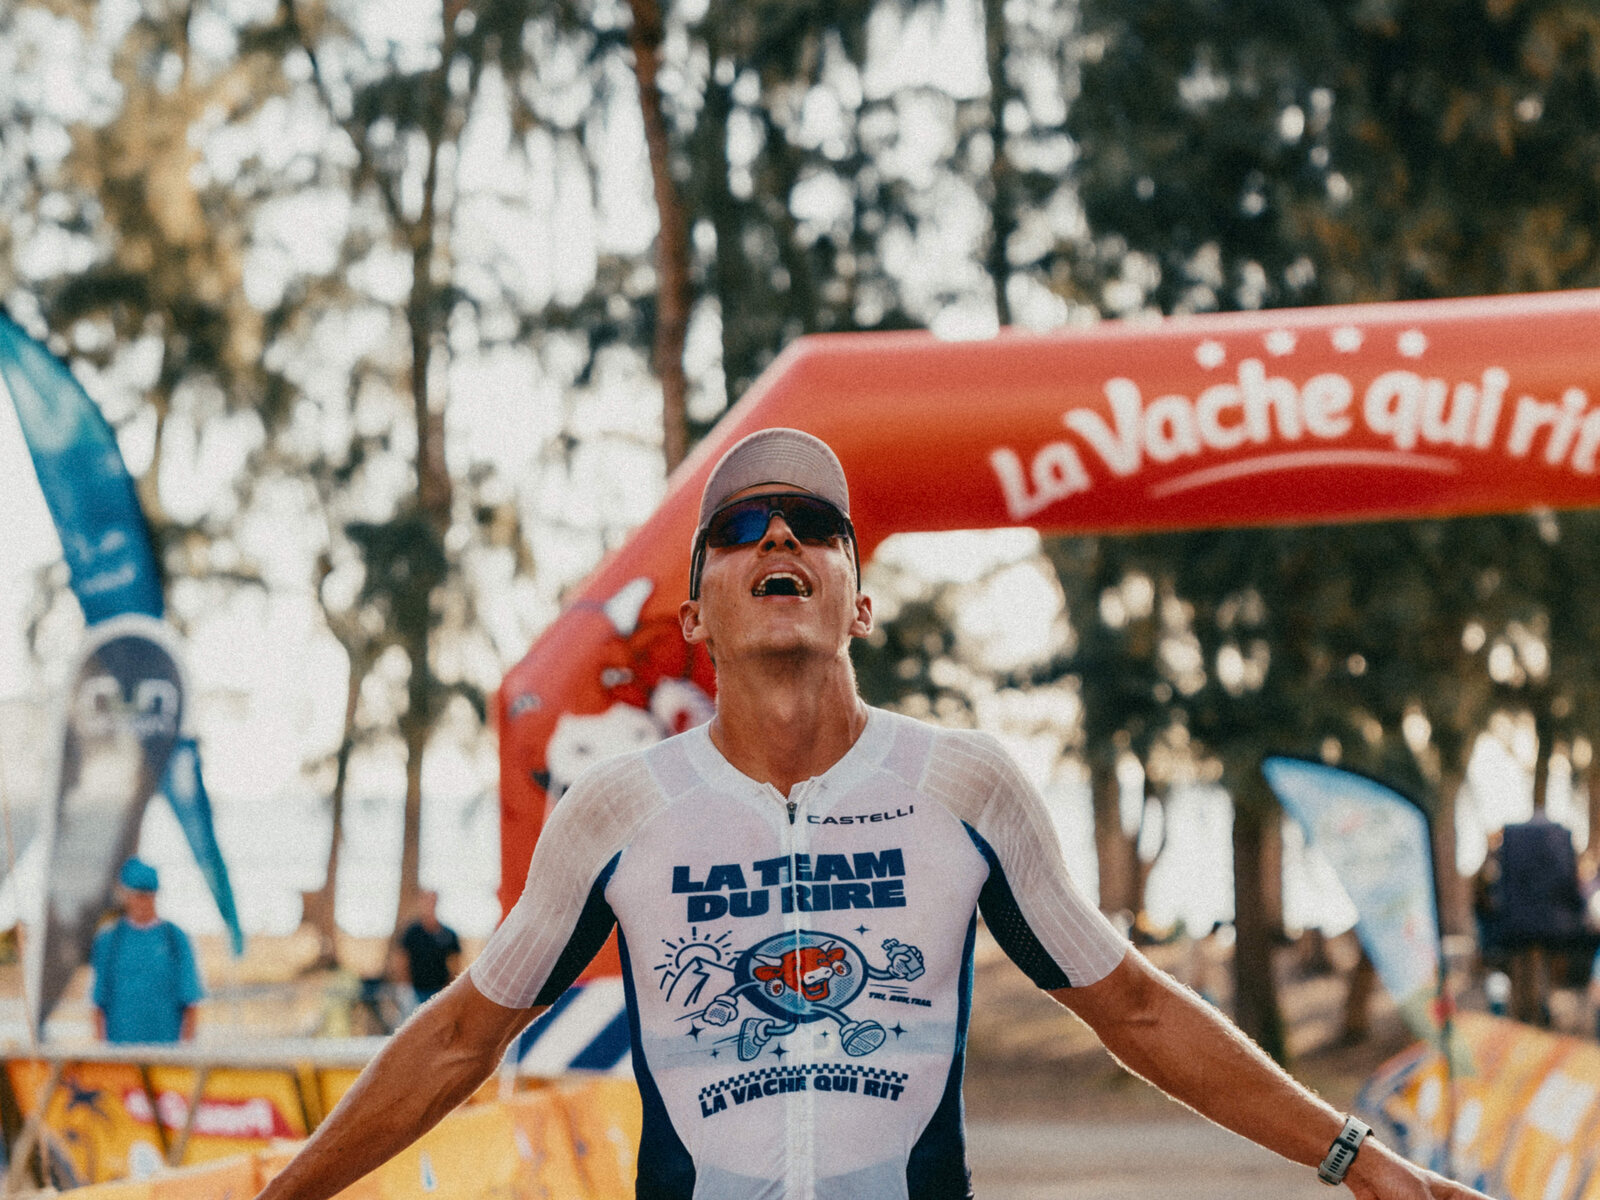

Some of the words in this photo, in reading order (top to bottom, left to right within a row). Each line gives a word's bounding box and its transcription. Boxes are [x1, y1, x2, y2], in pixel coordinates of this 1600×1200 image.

[989, 444, 1091, 519] La
[1063, 358, 1354, 477] Vache
[1363, 367, 1509, 450] qui
[807, 805, 914, 824] CASTELLI
[672, 864, 747, 894] LA
[753, 848, 906, 887] TEAM
[687, 890, 769, 923] DU
[781, 879, 907, 914] RIRE
[700, 1094, 728, 1118] LA
[731, 1075, 807, 1105] VACHE
[813, 1075, 858, 1093] QUI
[863, 1079, 905, 1101] RIT
